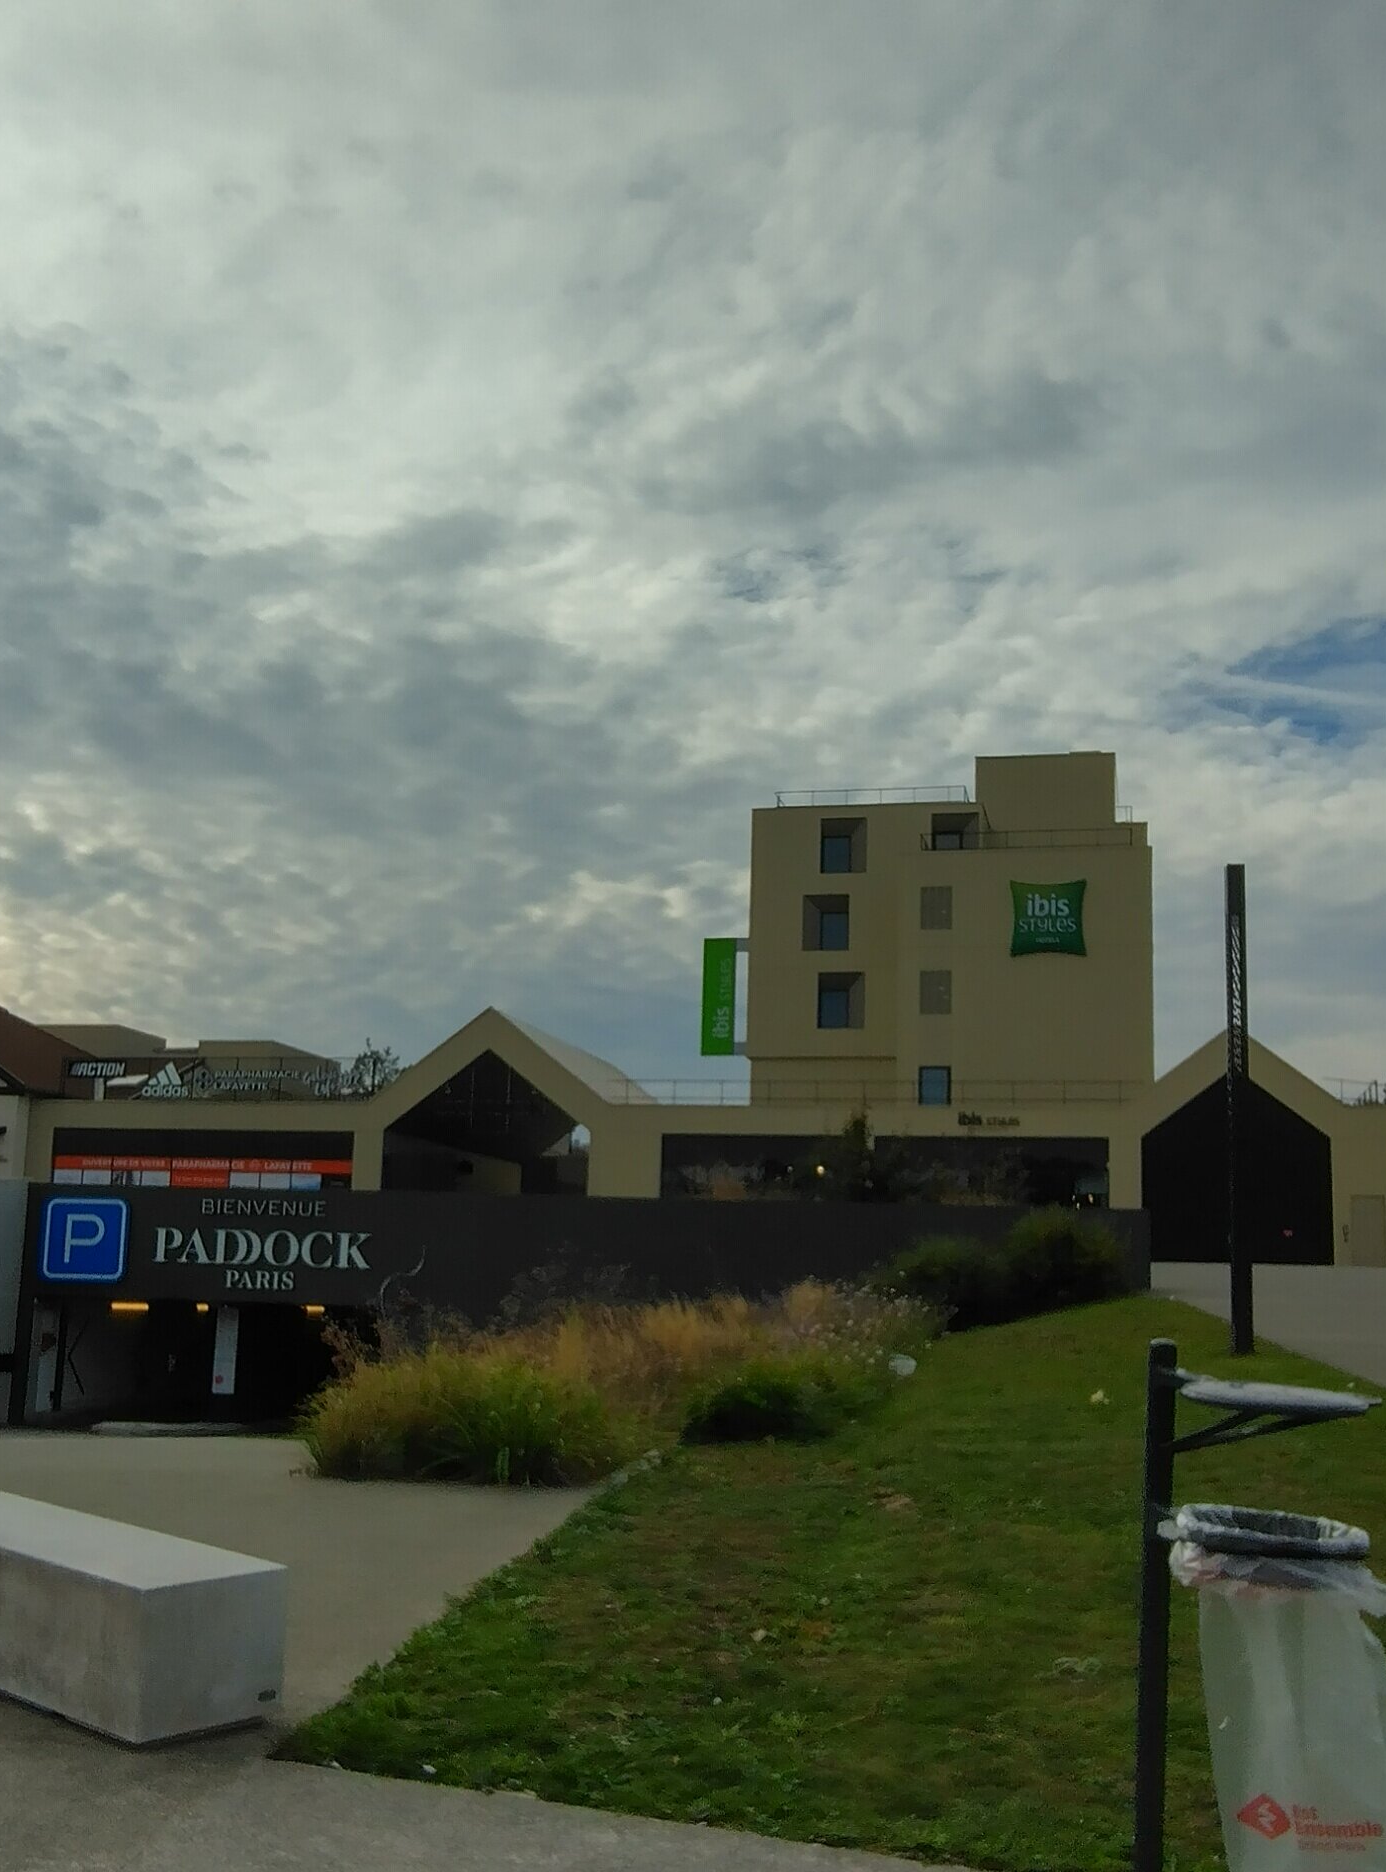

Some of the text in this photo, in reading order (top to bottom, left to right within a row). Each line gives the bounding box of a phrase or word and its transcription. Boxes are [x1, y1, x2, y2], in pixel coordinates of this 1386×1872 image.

[1026, 892, 1070, 917] ibis
[711, 1007, 730, 1039] ibis
[76, 1062, 126, 1077] ACTION
[214, 1070, 299, 1079] PARAPHARMACIE
[141, 1085, 189, 1097] adidas
[213, 1081, 270, 1091] LAFAYETTE
[201, 1198, 327, 1218] BIENVENUE
[63, 1213, 105, 1264] P
[152, 1226, 372, 1270] PADDOCK
[224, 1269, 294, 1291] PARIS
